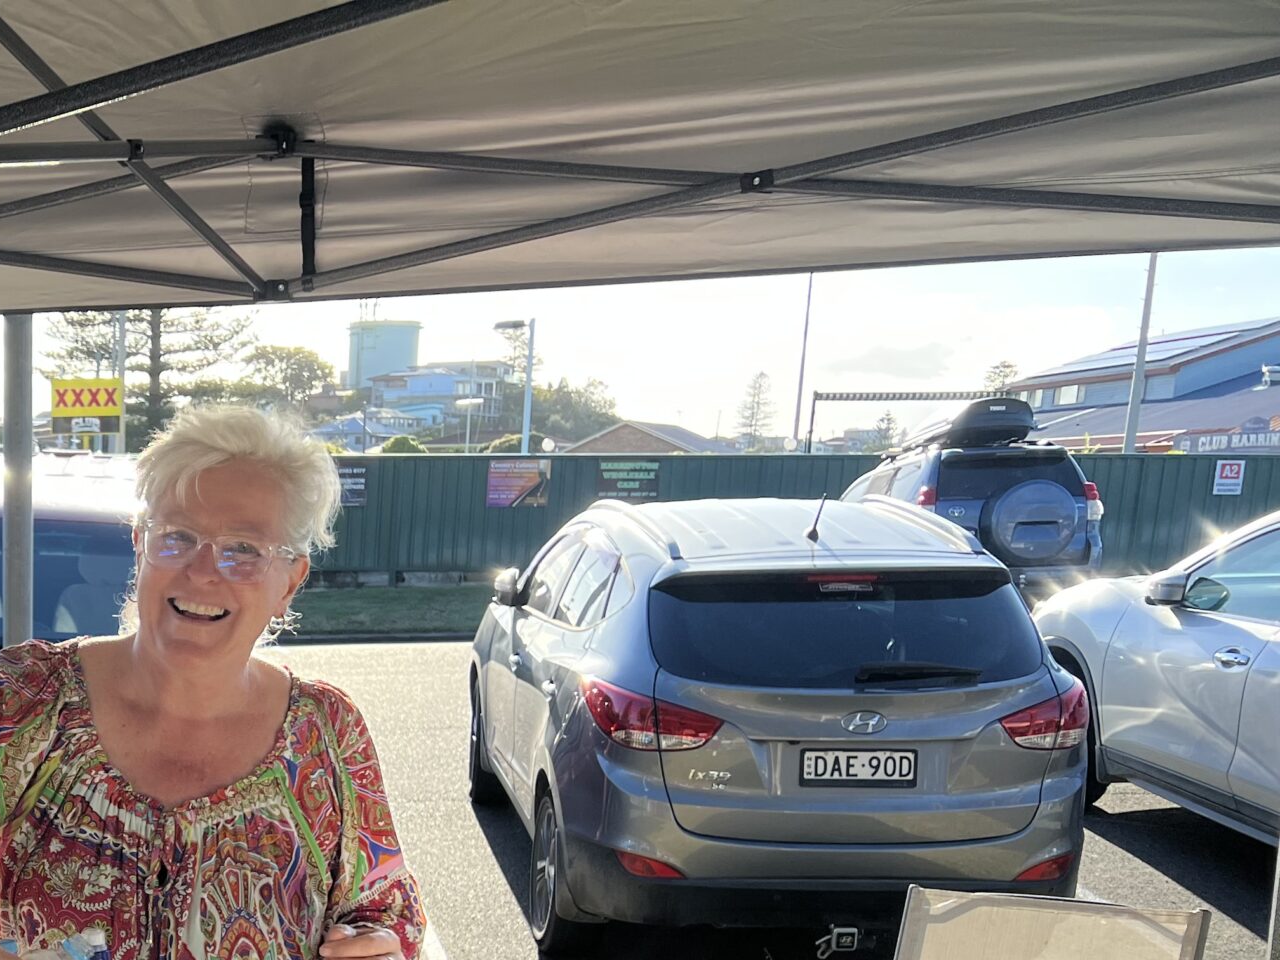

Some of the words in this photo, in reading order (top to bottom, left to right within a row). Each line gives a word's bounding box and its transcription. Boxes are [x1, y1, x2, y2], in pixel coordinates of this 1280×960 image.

[54, 387, 118, 408] XXXX
[1198, 435, 1229, 452] CLUB
[1221, 464, 1239, 478] A2
